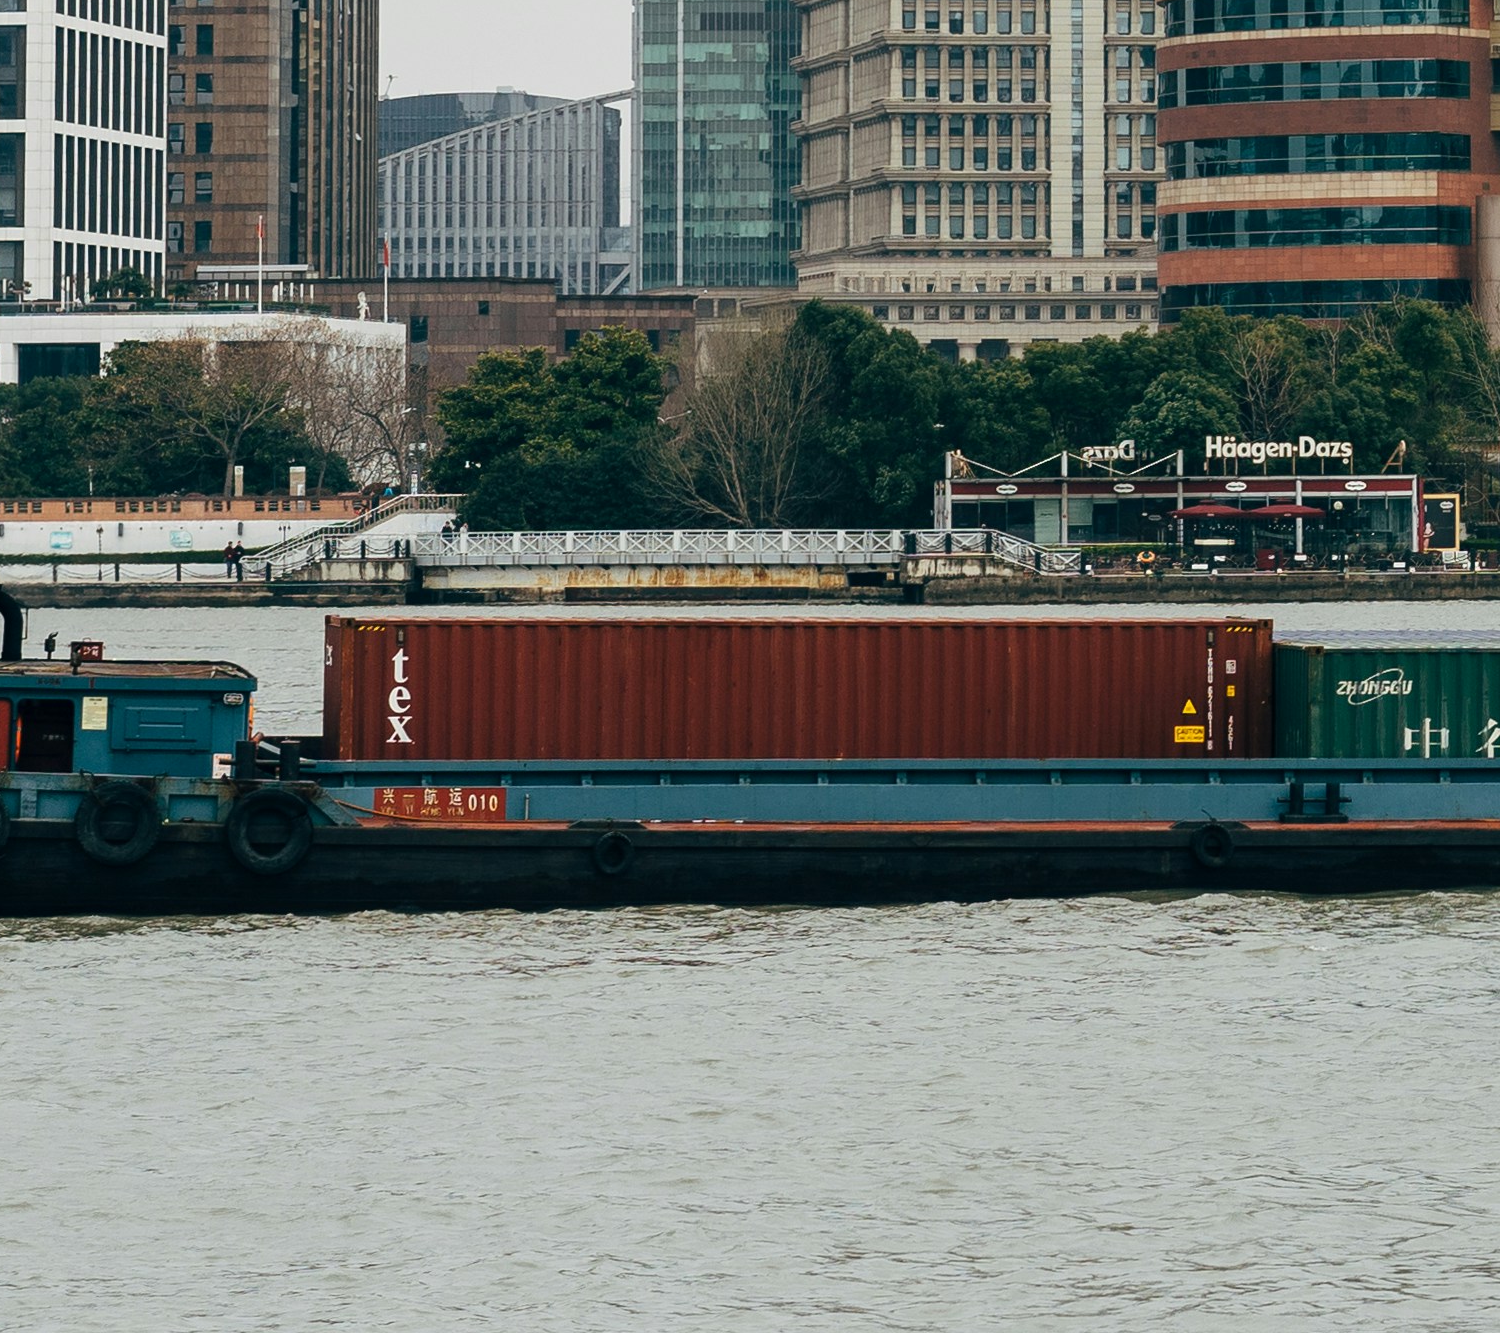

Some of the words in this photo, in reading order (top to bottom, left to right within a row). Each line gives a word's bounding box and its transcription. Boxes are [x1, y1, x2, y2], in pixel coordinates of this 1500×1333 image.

[1205, 435, 1353, 469] Häagen-Dazs
[386, 648, 414, 744] tex
[1336, 679, 1413, 696] ZHONGGU
[383, 788, 463, 806] 兴一航运
[468, 794, 498, 811] 010
